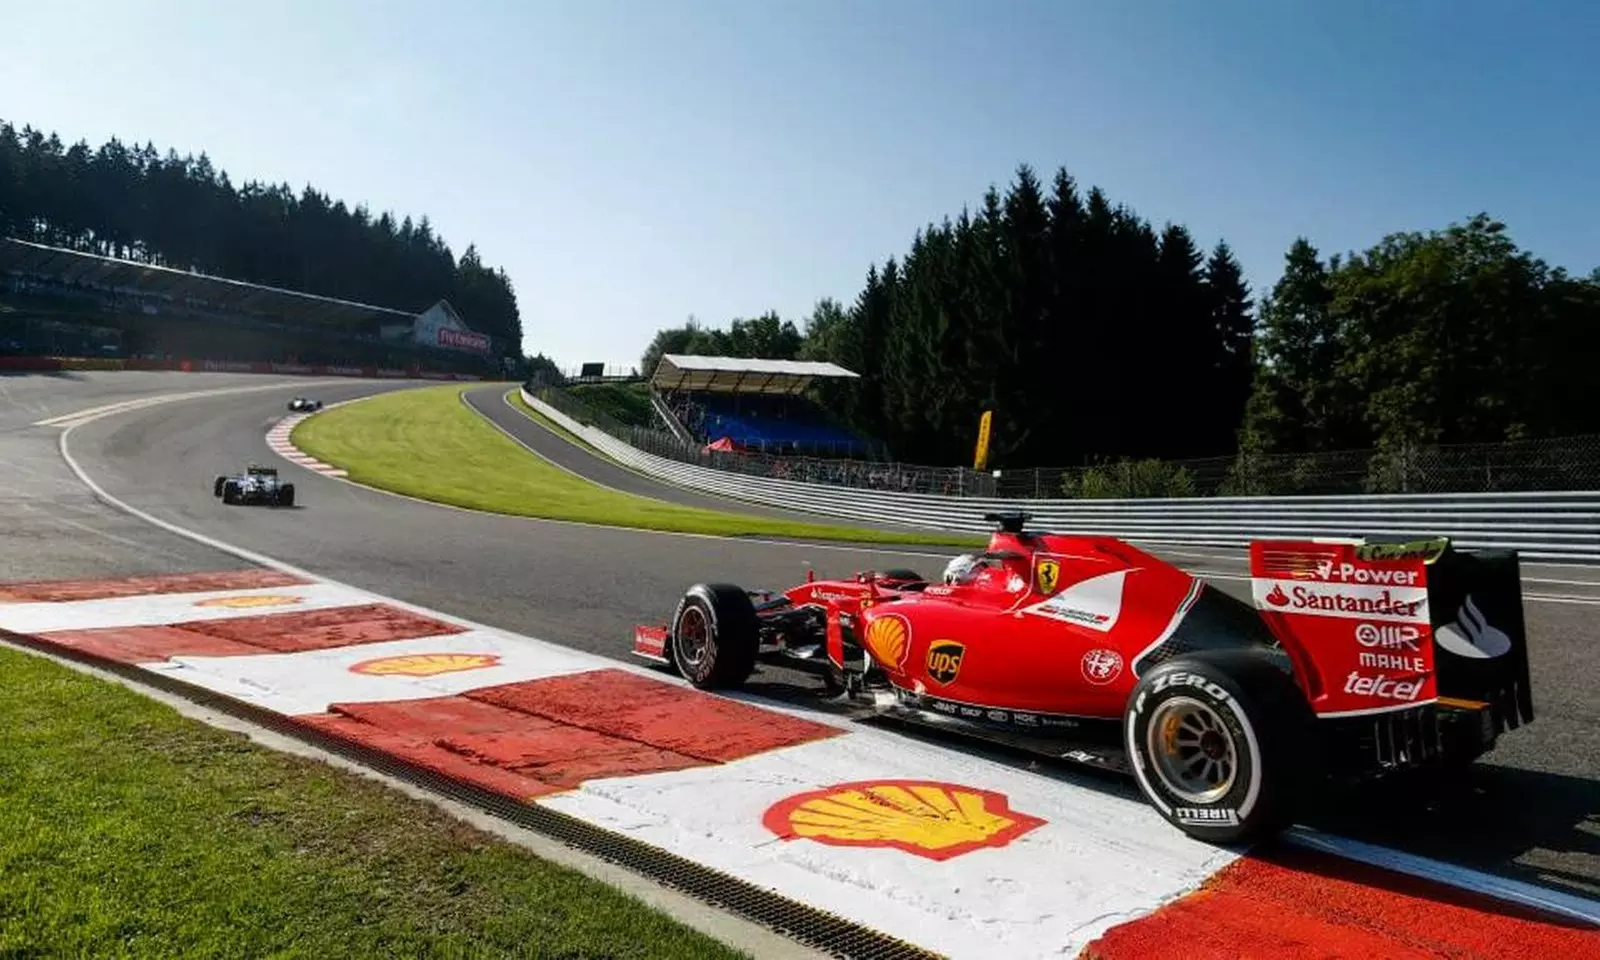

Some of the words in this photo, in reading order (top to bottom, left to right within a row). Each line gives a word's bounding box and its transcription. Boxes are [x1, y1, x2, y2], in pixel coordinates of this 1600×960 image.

[1292, 586, 1420, 617] Santander
[929, 651, 961, 680] ups
[1359, 652, 1426, 673] MAHLE
[1152, 672, 1230, 701] ZERO
[1343, 671, 1426, 701] telcel
